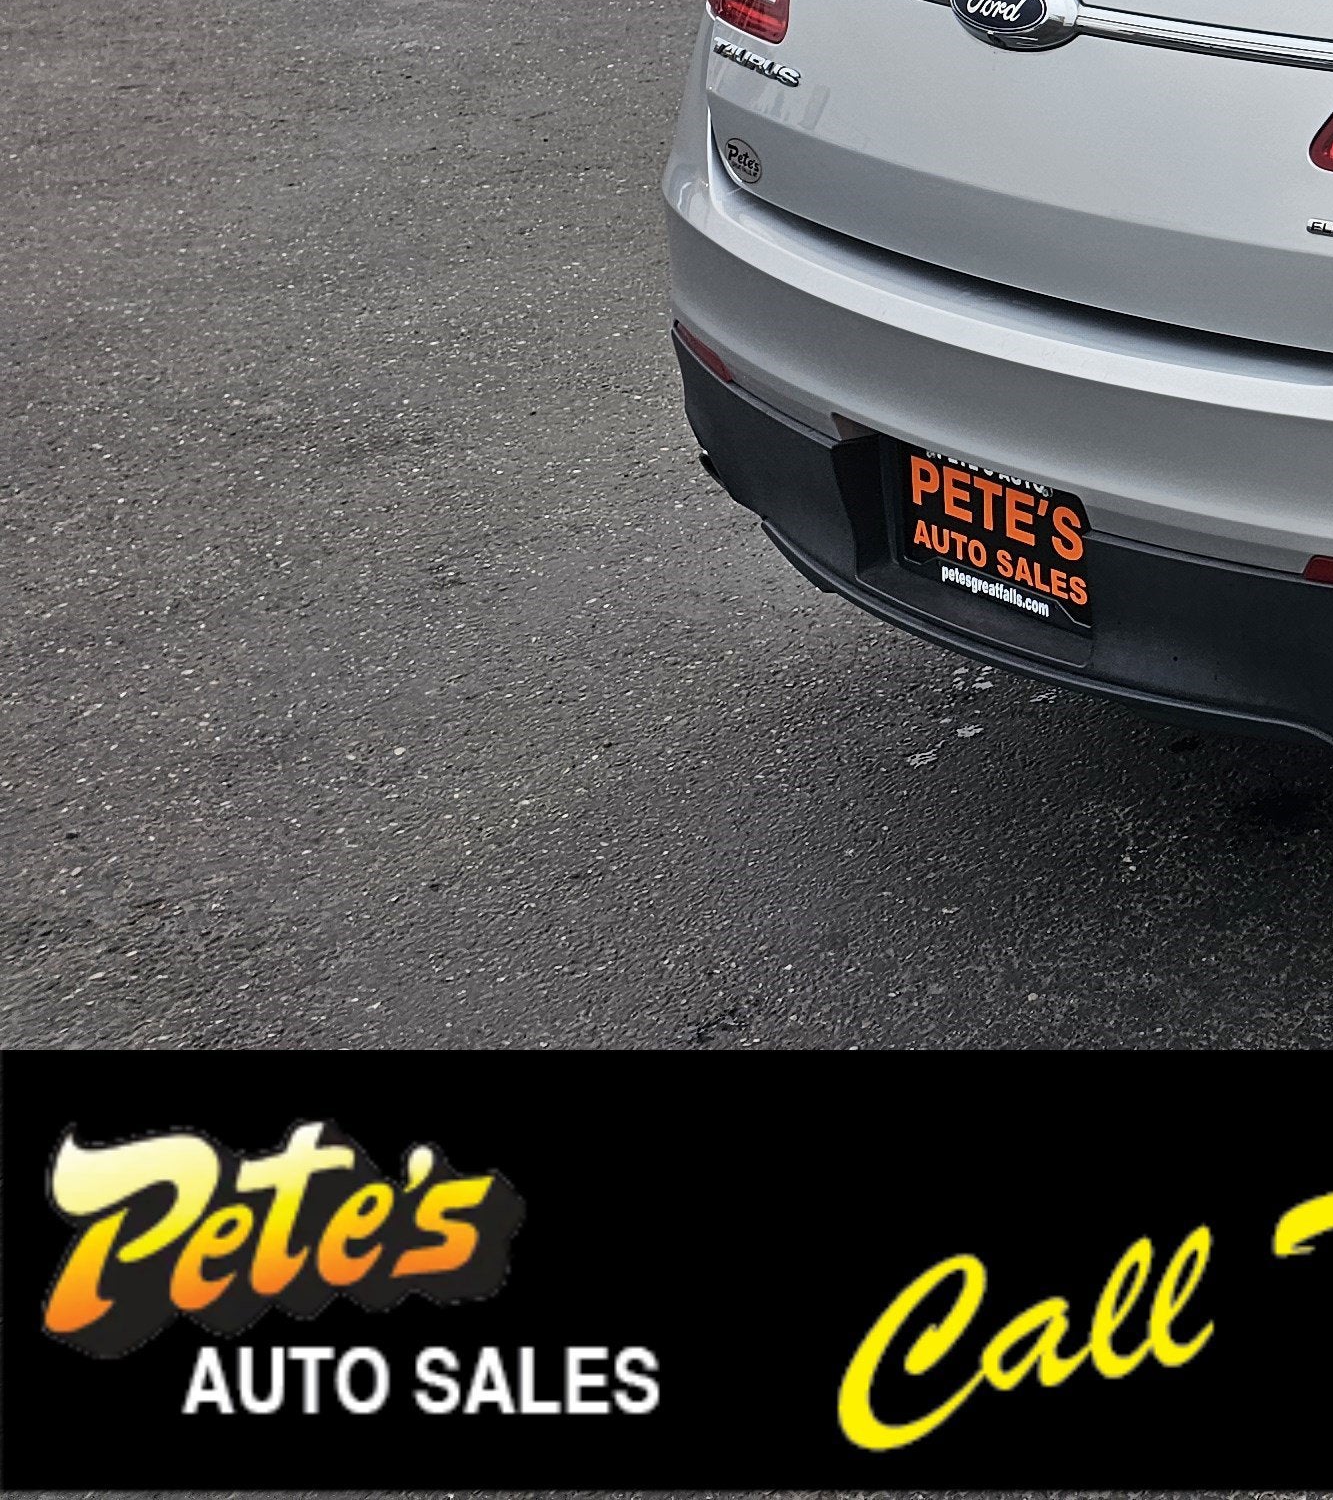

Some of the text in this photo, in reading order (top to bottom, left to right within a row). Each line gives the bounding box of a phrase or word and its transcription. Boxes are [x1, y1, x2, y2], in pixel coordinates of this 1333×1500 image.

[713, 37, 801, 87] TAURUS
[911, 455, 1084, 561] PETE'S
[914, 519, 1088, 605] AUTO SALES
[941, 565, 1051, 618] petesgreatfalls.com
